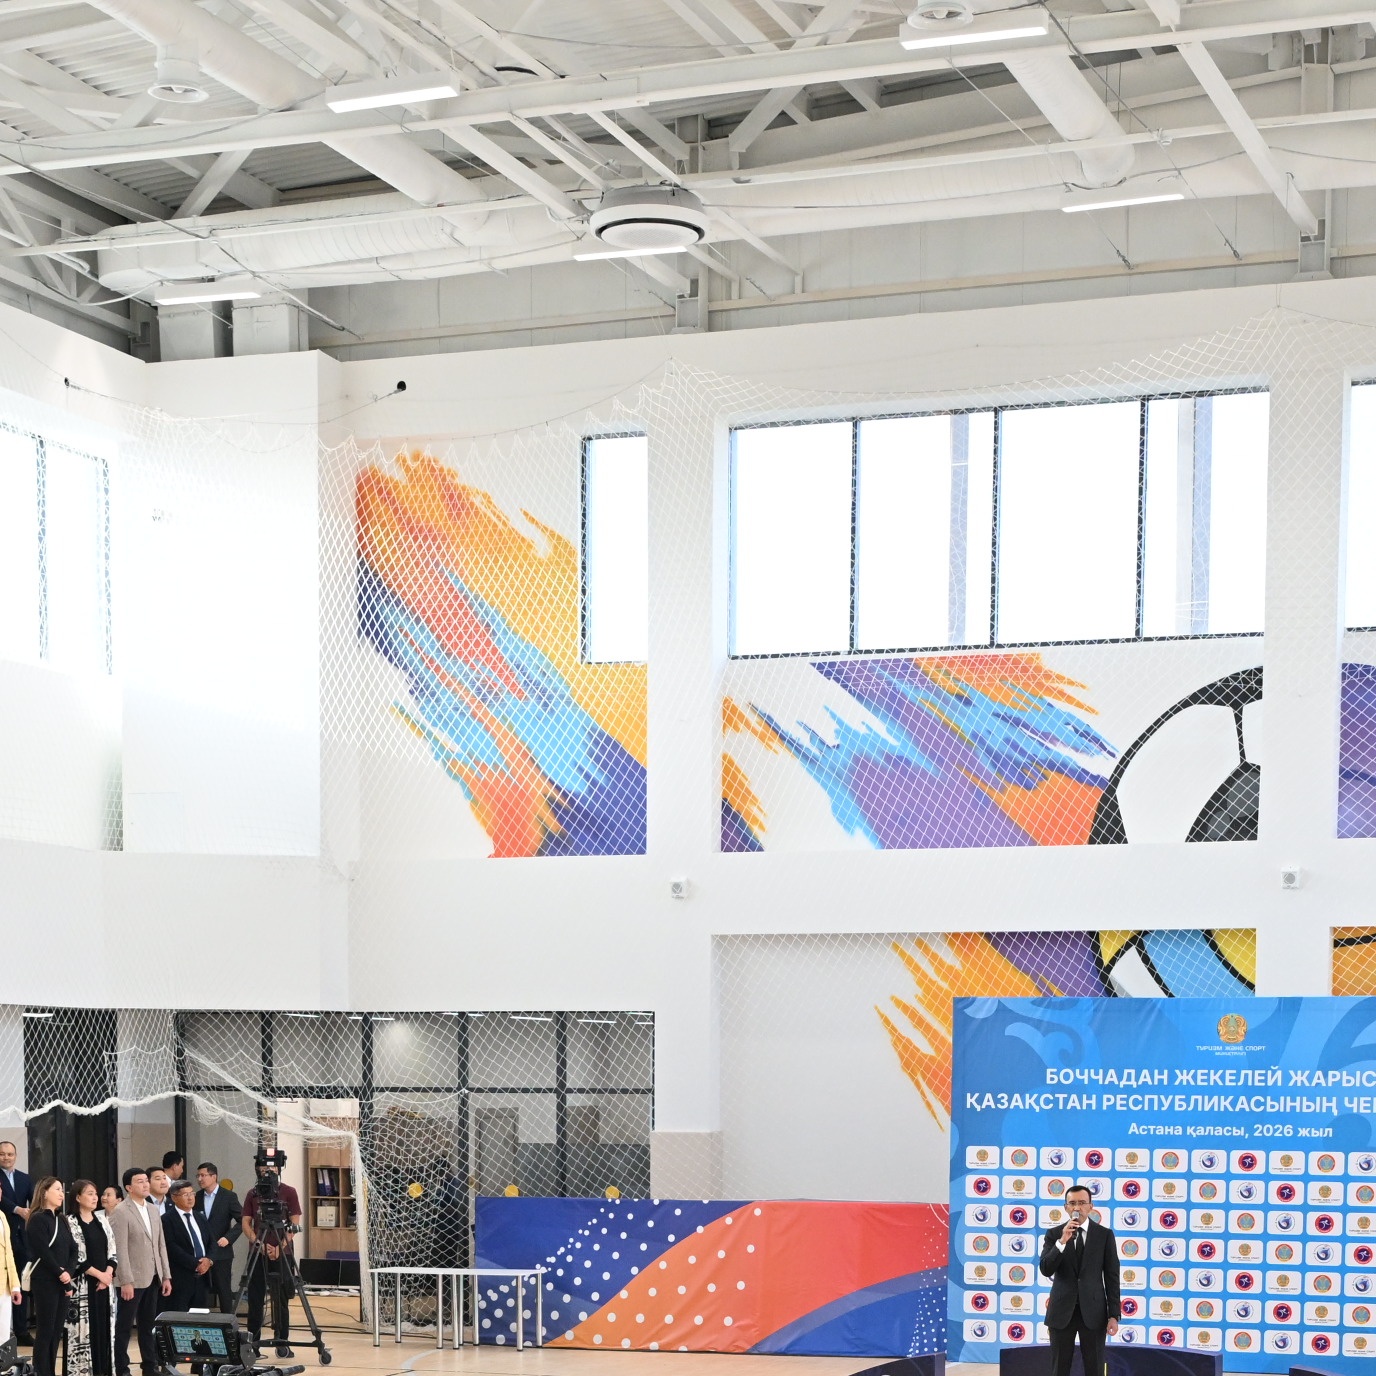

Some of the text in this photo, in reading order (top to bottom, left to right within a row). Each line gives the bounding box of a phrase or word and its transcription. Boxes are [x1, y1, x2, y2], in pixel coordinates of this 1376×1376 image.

[1045, 1068, 1169, 1088] БОЧЧАДАН
[1174, 1066, 1283, 1088] ЖЕКЕЛЕЙ
[965, 1092, 1097, 1112] ҚАЗАҚСТАН
[1101, 1094, 1339, 1116] РЕСПУБЛИКАСЫНЫҢ
[1127, 1122, 1334, 1139] Астана қаласы, 2026 жыл
